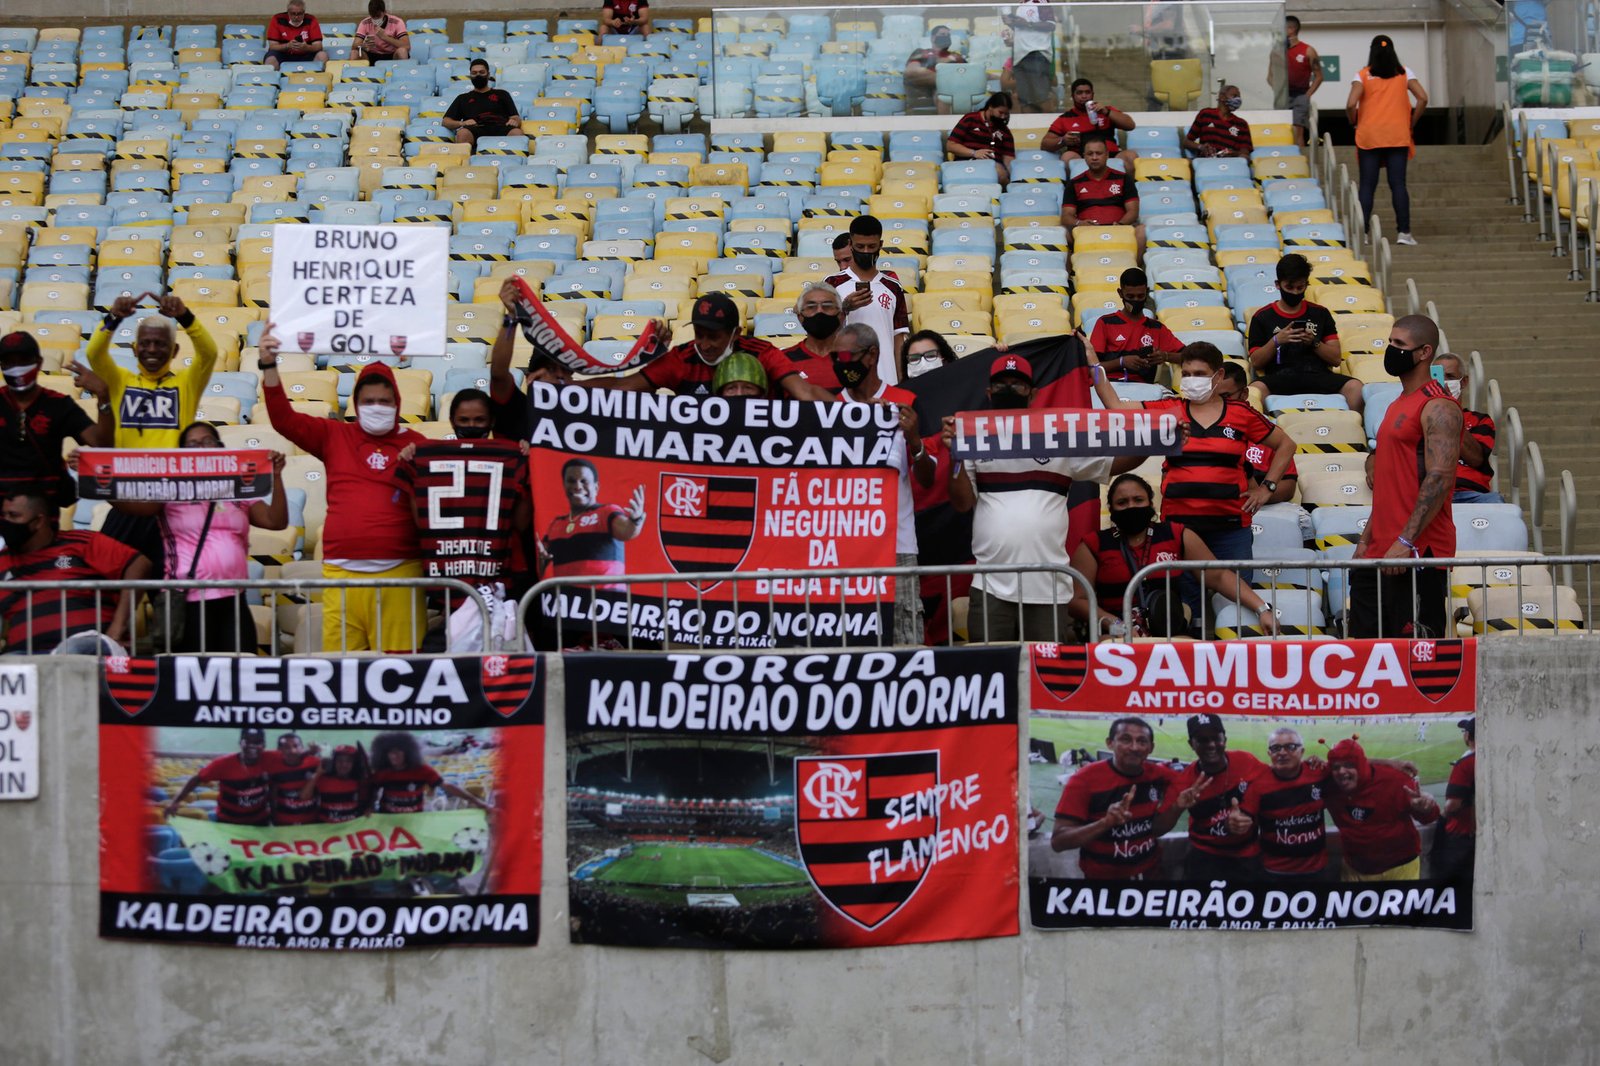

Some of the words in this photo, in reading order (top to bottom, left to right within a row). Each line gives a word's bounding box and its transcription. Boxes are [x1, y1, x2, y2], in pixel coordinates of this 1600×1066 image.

[315, 230, 397, 250] BRUNO
[293, 259, 415, 280] HENRIQUE
[304, 286, 416, 306] CERTEZA
[334, 310, 364, 329] DE
[330, 334, 379, 354] GOL
[124, 394, 175, 419] VAR
[533, 381, 730, 426] DOMINGO
[745, 399, 800, 429] EU
[815, 401, 900, 429] VOU
[531, 417, 598, 452] AO
[615, 428, 893, 466] MARACANÃ
[955, 415, 1031, 452] LEVI
[1043, 412, 1177, 449] ETERNO
[113, 454, 167, 474] MAURÍCIO
[169, 457, 179, 473] G.
[181, 456, 195, 472] DE
[196, 456, 238, 473] MATTOS
[116, 478, 176, 500] KALDEIRÃO
[179, 481, 194, 500] DO
[196, 480, 235, 499] NORMA
[428, 460, 504, 530] 27
[771, 472, 799, 506] FÃ
[807, 477, 883, 506] CLUBE
[763, 510, 887, 538] NEGUINHO
[808, 539, 839, 567] DA
[755, 568, 823, 596] BEIJA
[829, 570, 887, 597] FLOR
[541, 595, 706, 633] KALDEIRÃO
[712, 611, 761, 636] DO
[767, 612, 883, 636] NORMA
[673, 632, 710, 645] AMOR
[716, 636, 725, 646] E
[729, 635, 777, 648] PAIXÃO
[175, 657, 469, 704] MERICA
[667, 650, 936, 684] TORCIDA
[1093, 643, 1408, 689] SAMUCA
[195, 705, 294, 724] ANTIGO
[301, 707, 452, 725] GERALDINO
[807, 681, 862, 731] DO
[869, 672, 1006, 728] NORMA
[1126, 690, 1223, 708] ANTIGO
[1233, 691, 1379, 710] GERALDINO
[884, 773, 982, 830] SEMPRE
[230, 827, 423, 859] TORCIDA
[868, 814, 1009, 884] FLAMENGO
[234, 852, 383, 890] KALDEIRÃO
[1046, 881, 1253, 918] KALDEIRÃO
[1262, 891, 1318, 918] DO
[1325, 887, 1456, 918] NORMA
[116, 897, 322, 935] KALDEIRÃO
[330, 907, 387, 935] DO
[393, 903, 529, 934] NORMA
[1218, 920, 1261, 930] AMOR
[1282, 918, 1336, 930] PAIXÃO
[285, 936, 330, 949] AMOR
[335, 937, 345, 949] E
[351, 934, 405, 949] PAIXÃO
